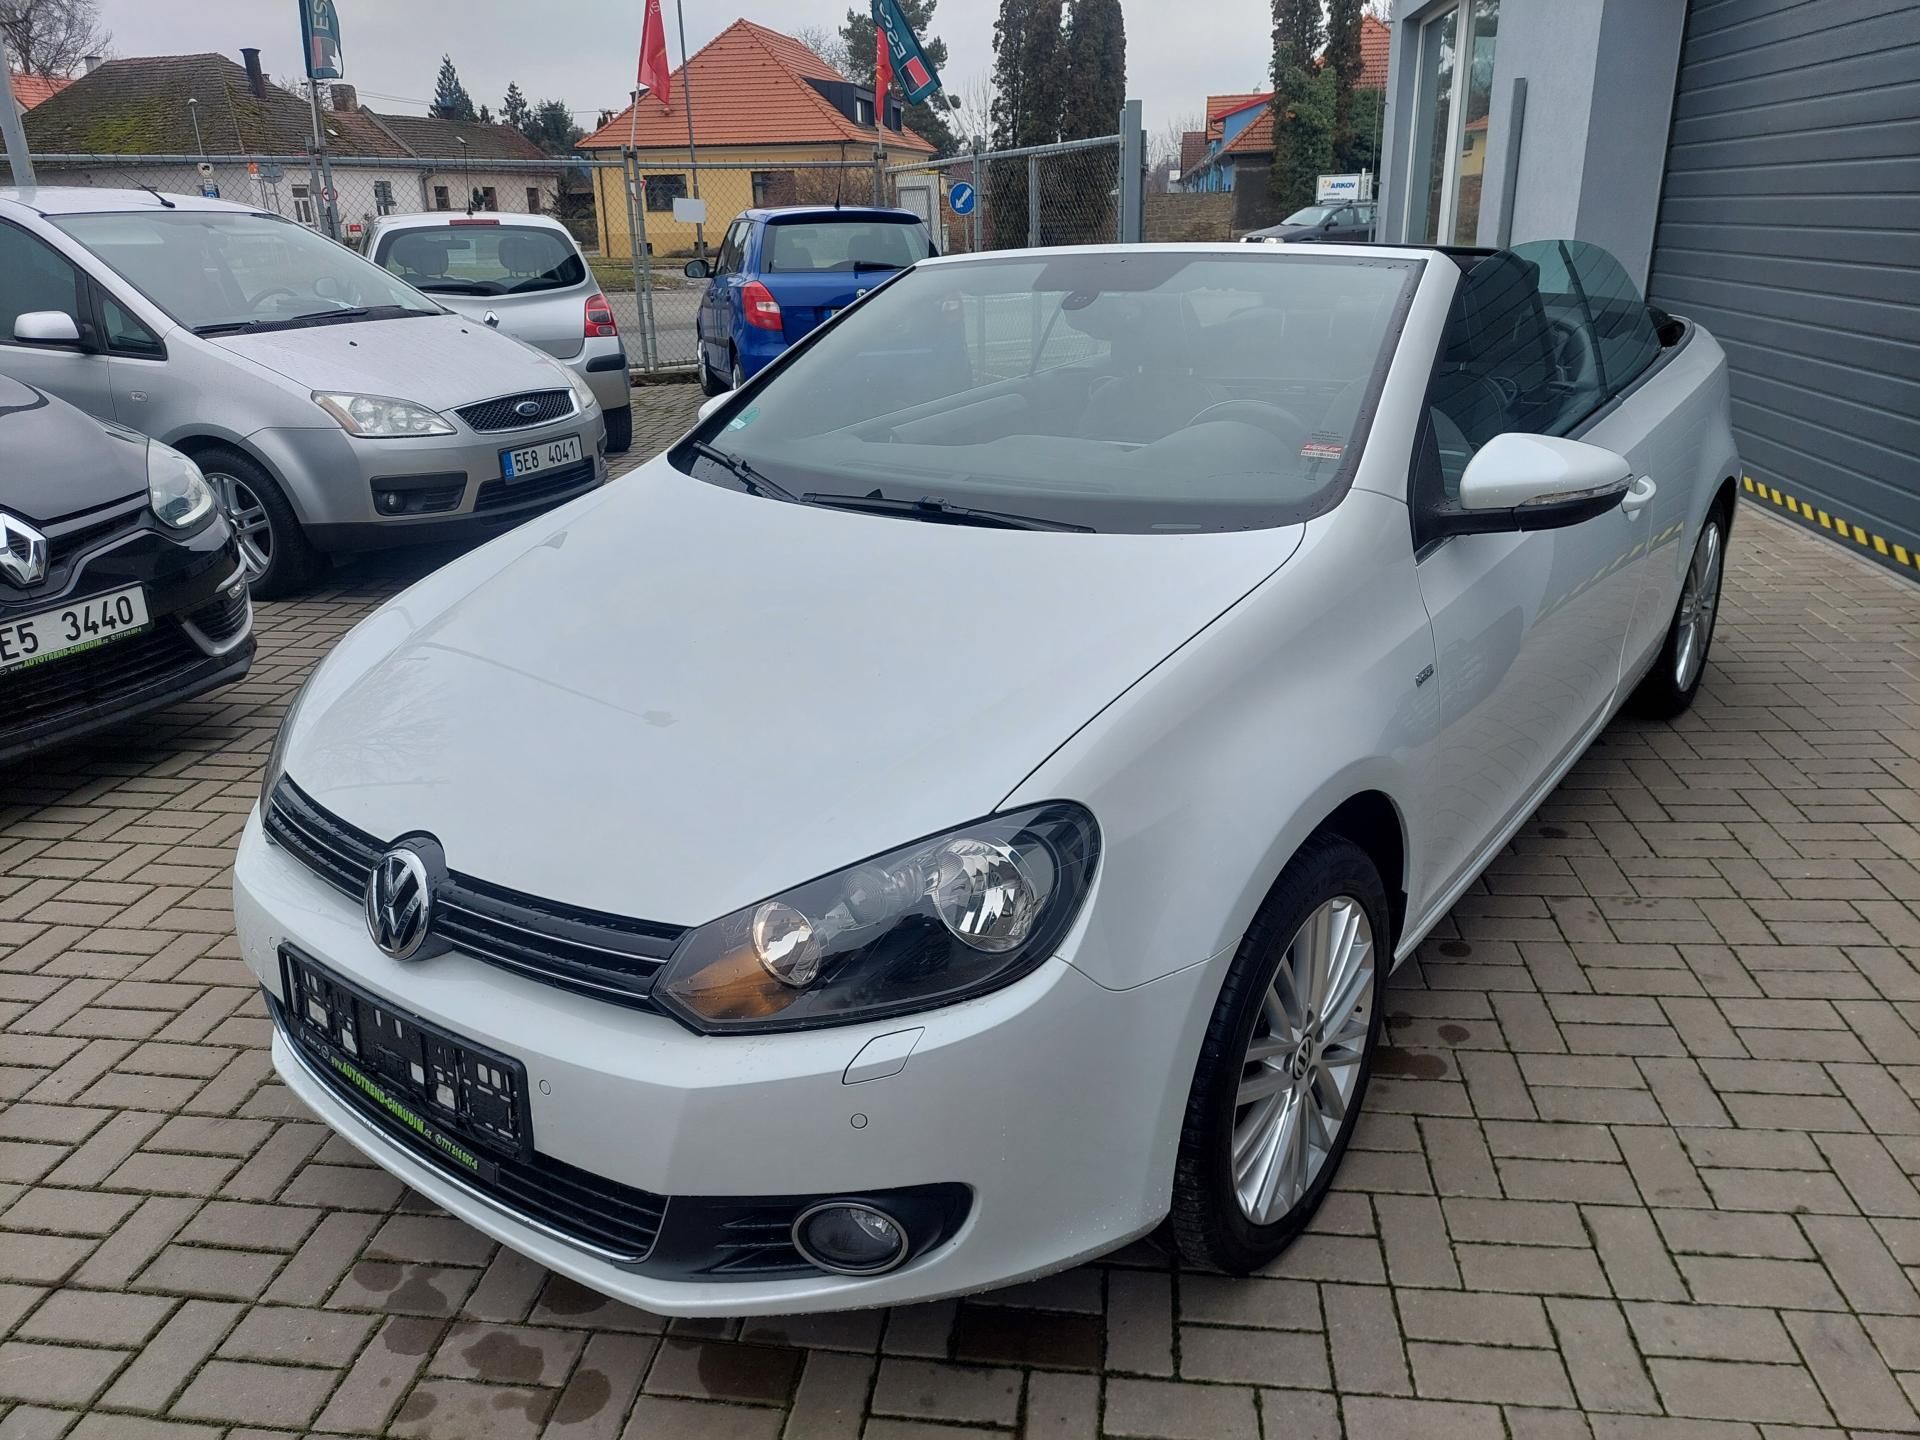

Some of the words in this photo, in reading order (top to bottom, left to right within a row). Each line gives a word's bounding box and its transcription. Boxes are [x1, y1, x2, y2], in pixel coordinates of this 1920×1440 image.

[1330, 181, 1356, 189] ARKOV
[514, 450, 540, 473] 5E8
[548, 440, 577, 465] 4041
[61, 595, 134, 641] 3440
